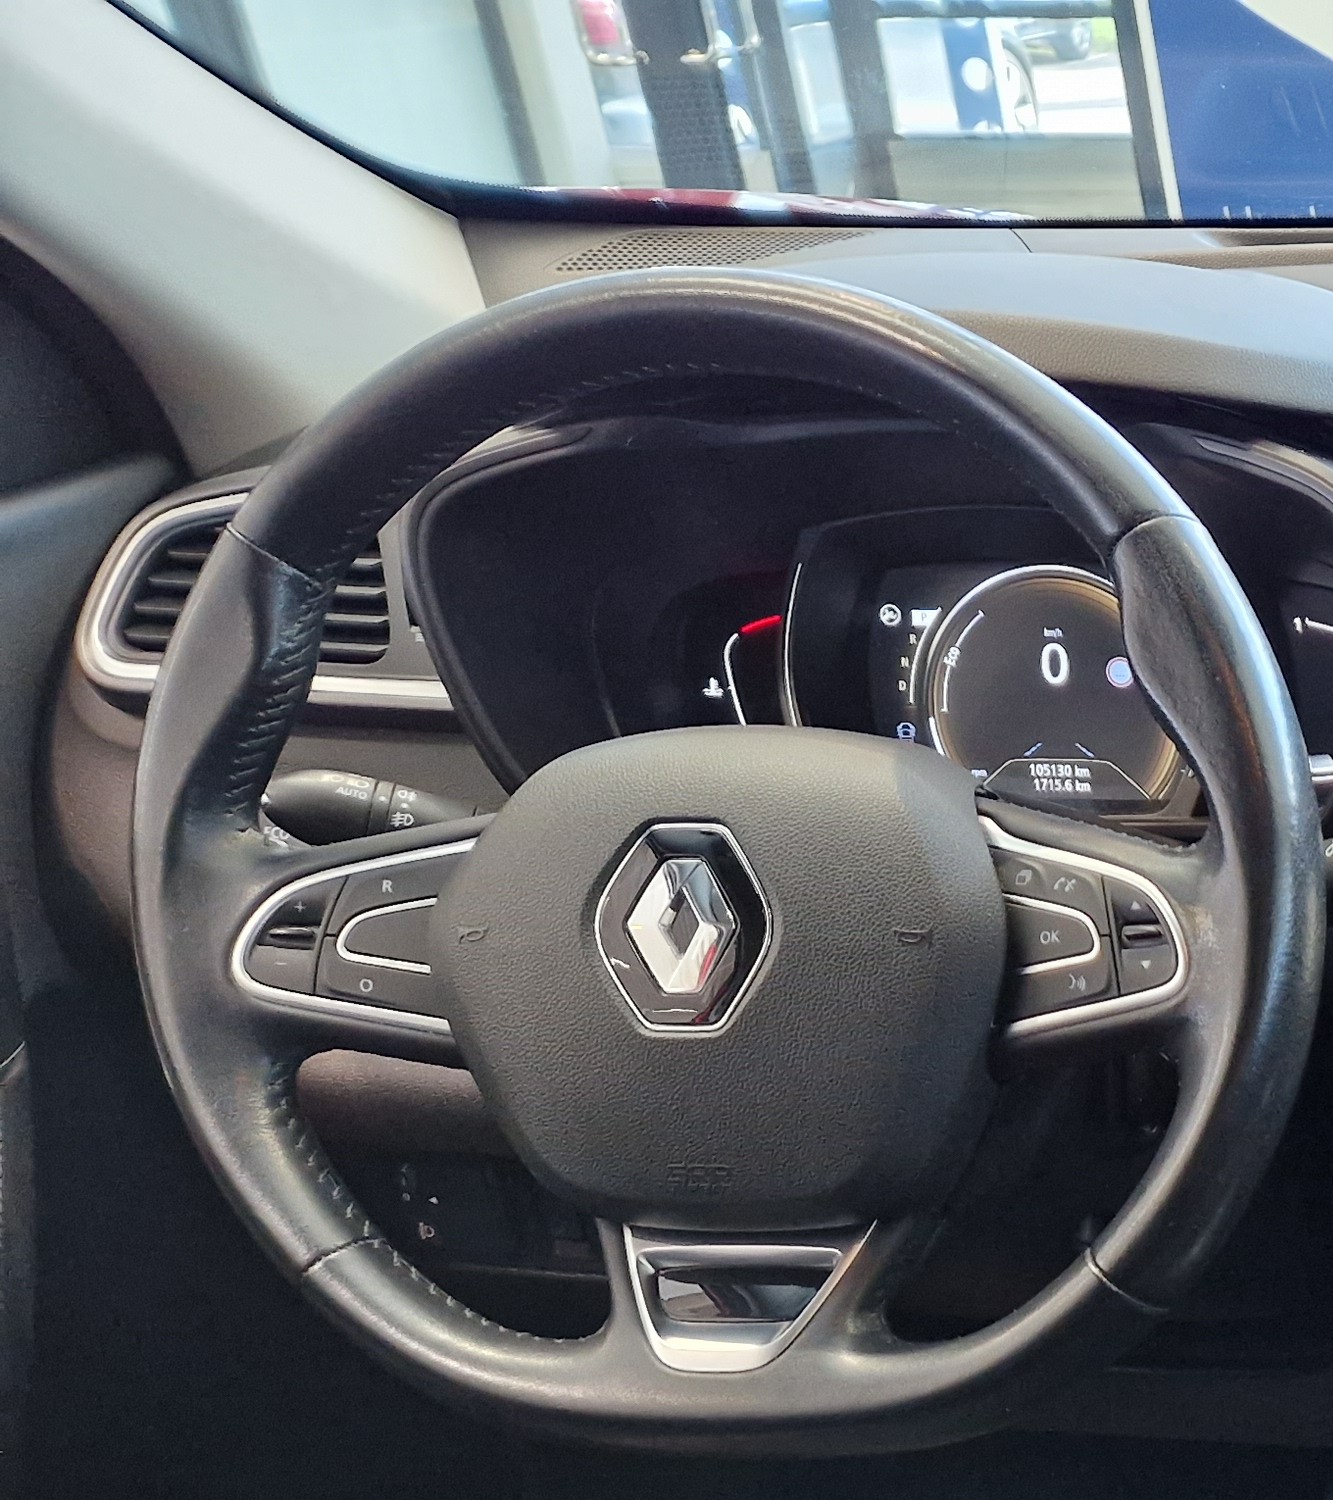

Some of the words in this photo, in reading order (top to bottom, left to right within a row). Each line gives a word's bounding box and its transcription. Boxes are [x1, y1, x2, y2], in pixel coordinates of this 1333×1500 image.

[909, 633, 917, 645] R
[900, 656, 910, 668] N
[1041, 642, 1070, 686] 0
[898, 680, 907, 692] D
[1029, 763, 1072, 778] 105130
[1074, 764, 1092, 778] km
[1033, 778, 1073, 792] 1715.6
[1075, 779, 1092, 792] km
[336, 786, 368, 800] AUTO
[381, 879, 393, 893] R
[1039, 931, 1061, 945] OK
